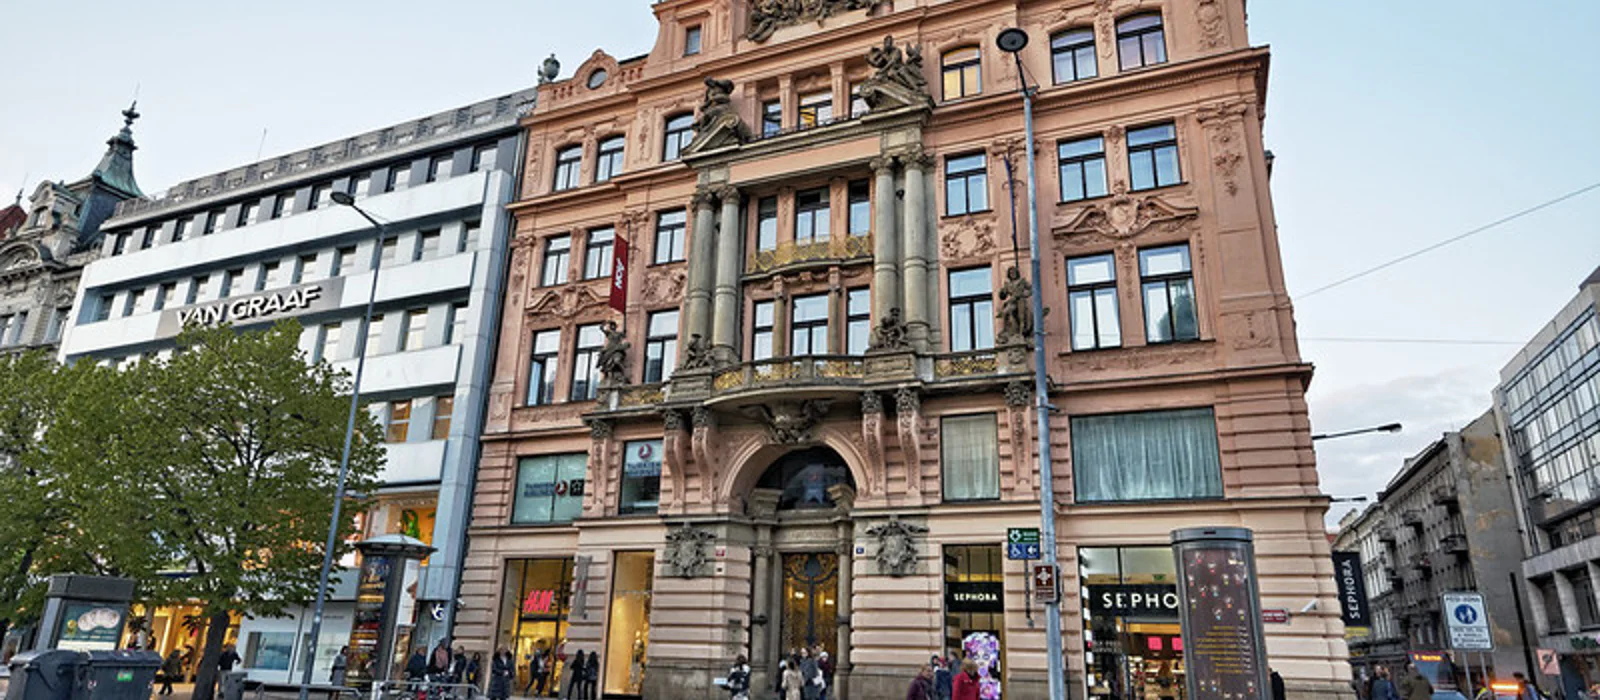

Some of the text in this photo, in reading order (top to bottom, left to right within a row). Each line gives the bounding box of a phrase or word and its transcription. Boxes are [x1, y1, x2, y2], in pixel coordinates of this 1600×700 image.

[176, 285, 321, 328] VAN GRAAF
[523, 589, 555, 614] H&M
[953, 593, 999, 602] SEPHORA
[1101, 592, 1179, 609] SEPHO
[1341, 559, 1361, 620] SEPHORA
